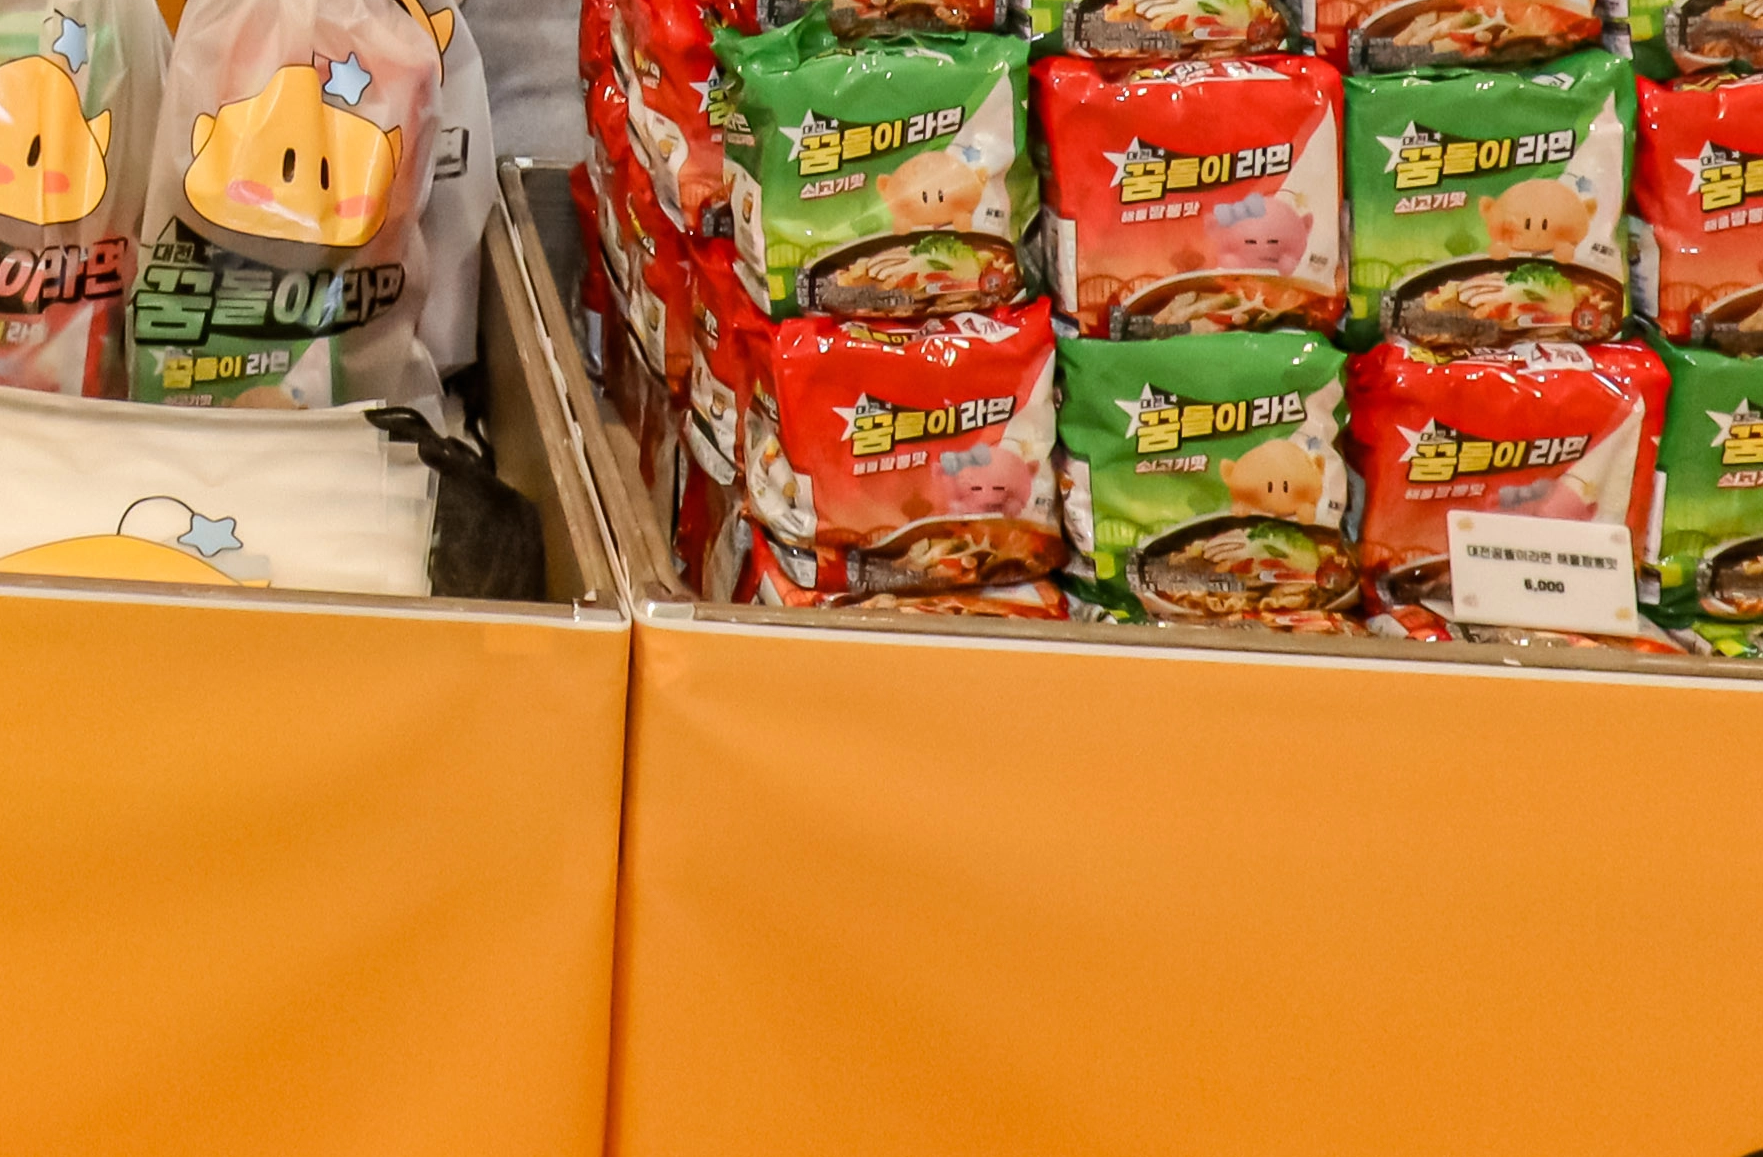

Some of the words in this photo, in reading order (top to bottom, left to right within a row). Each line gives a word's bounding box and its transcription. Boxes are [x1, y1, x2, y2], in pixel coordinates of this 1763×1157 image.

[799, 120, 903, 176] 꿈돌이
[906, 105, 965, 144] 라면
[1394, 138, 1512, 190] 꿈돌이
[1515, 129, 1576, 165] 라면
[1121, 153, 1232, 204] 꿈돌이
[1236, 142, 1292, 179] 라면
[134, 264, 334, 346] 꿈돌이
[852, 406, 958, 456] 꿈돌이
[960, 395, 1016, 430] 라면
[1137, 400, 1249, 454] 꿈돌이
[1406, 439, 1527, 483] 꿈돌이
[1527, 434, 1591, 466] 라면
[1523, 578, 1565, 594] 6,000
